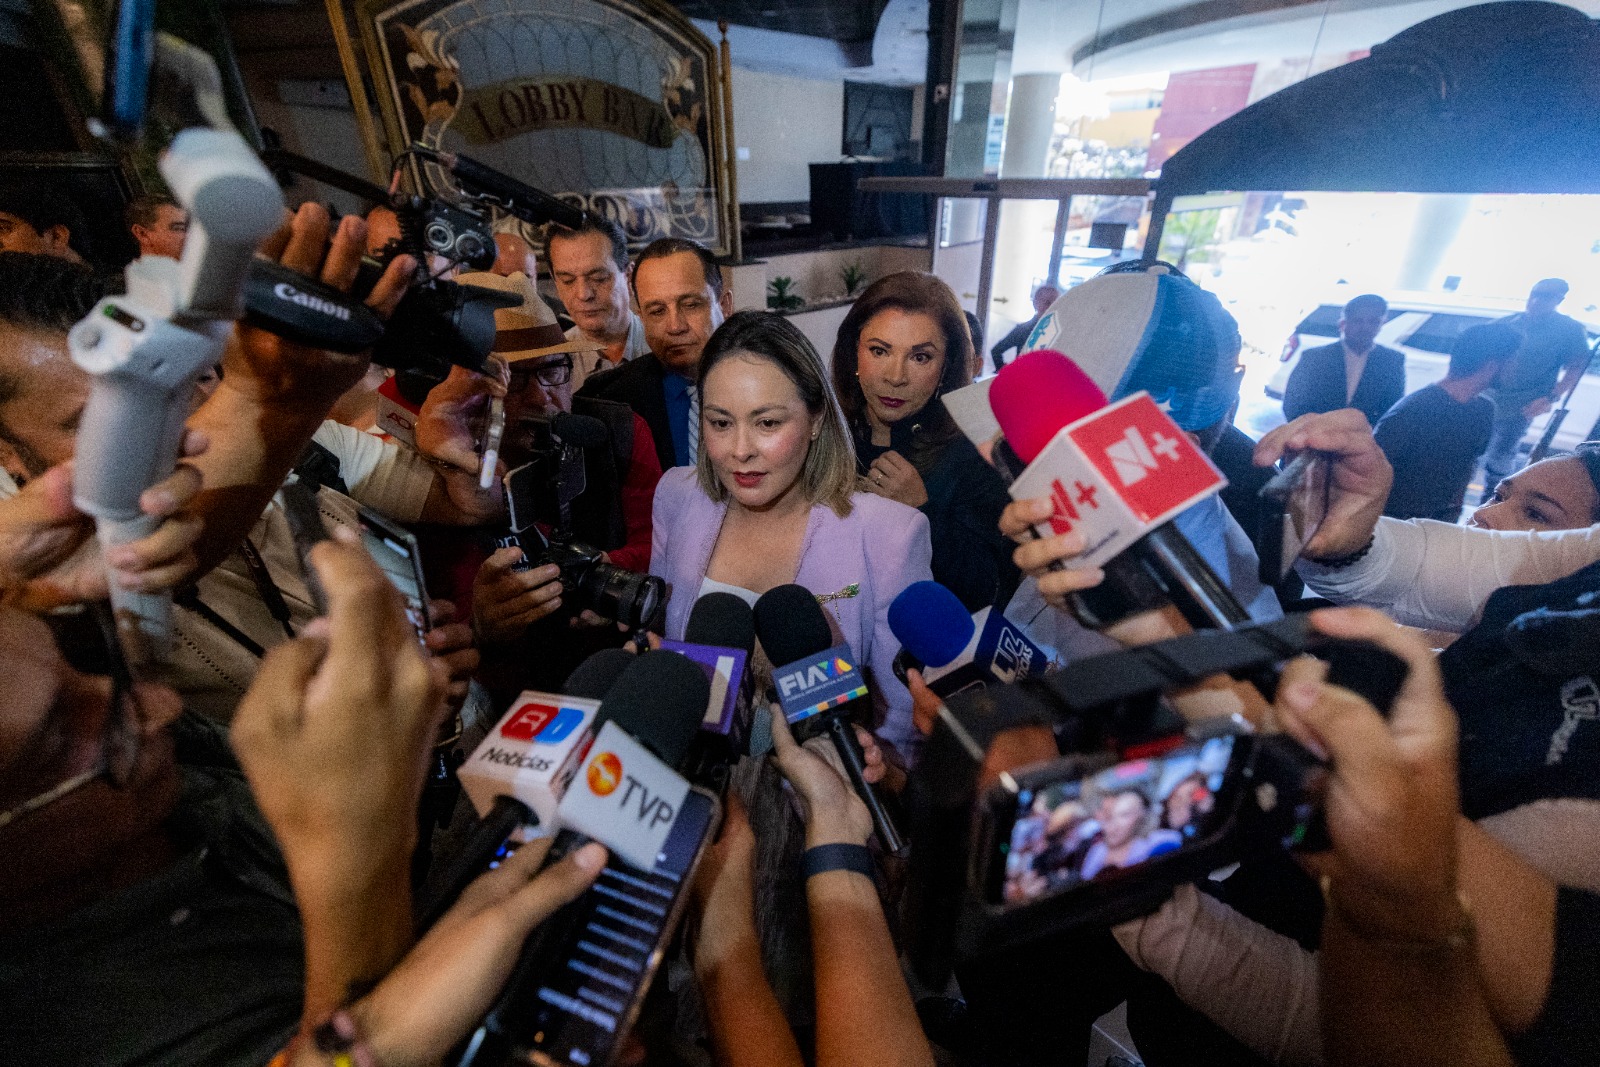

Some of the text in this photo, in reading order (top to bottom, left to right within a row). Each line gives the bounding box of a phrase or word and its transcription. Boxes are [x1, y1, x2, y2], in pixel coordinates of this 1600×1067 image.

[471, 81, 586, 140] LOBBY
[274, 283, 351, 321] Canon
[778, 665, 829, 698] FIA
[479, 746, 553, 772] Noticias
[619, 774, 674, 831] TVP
